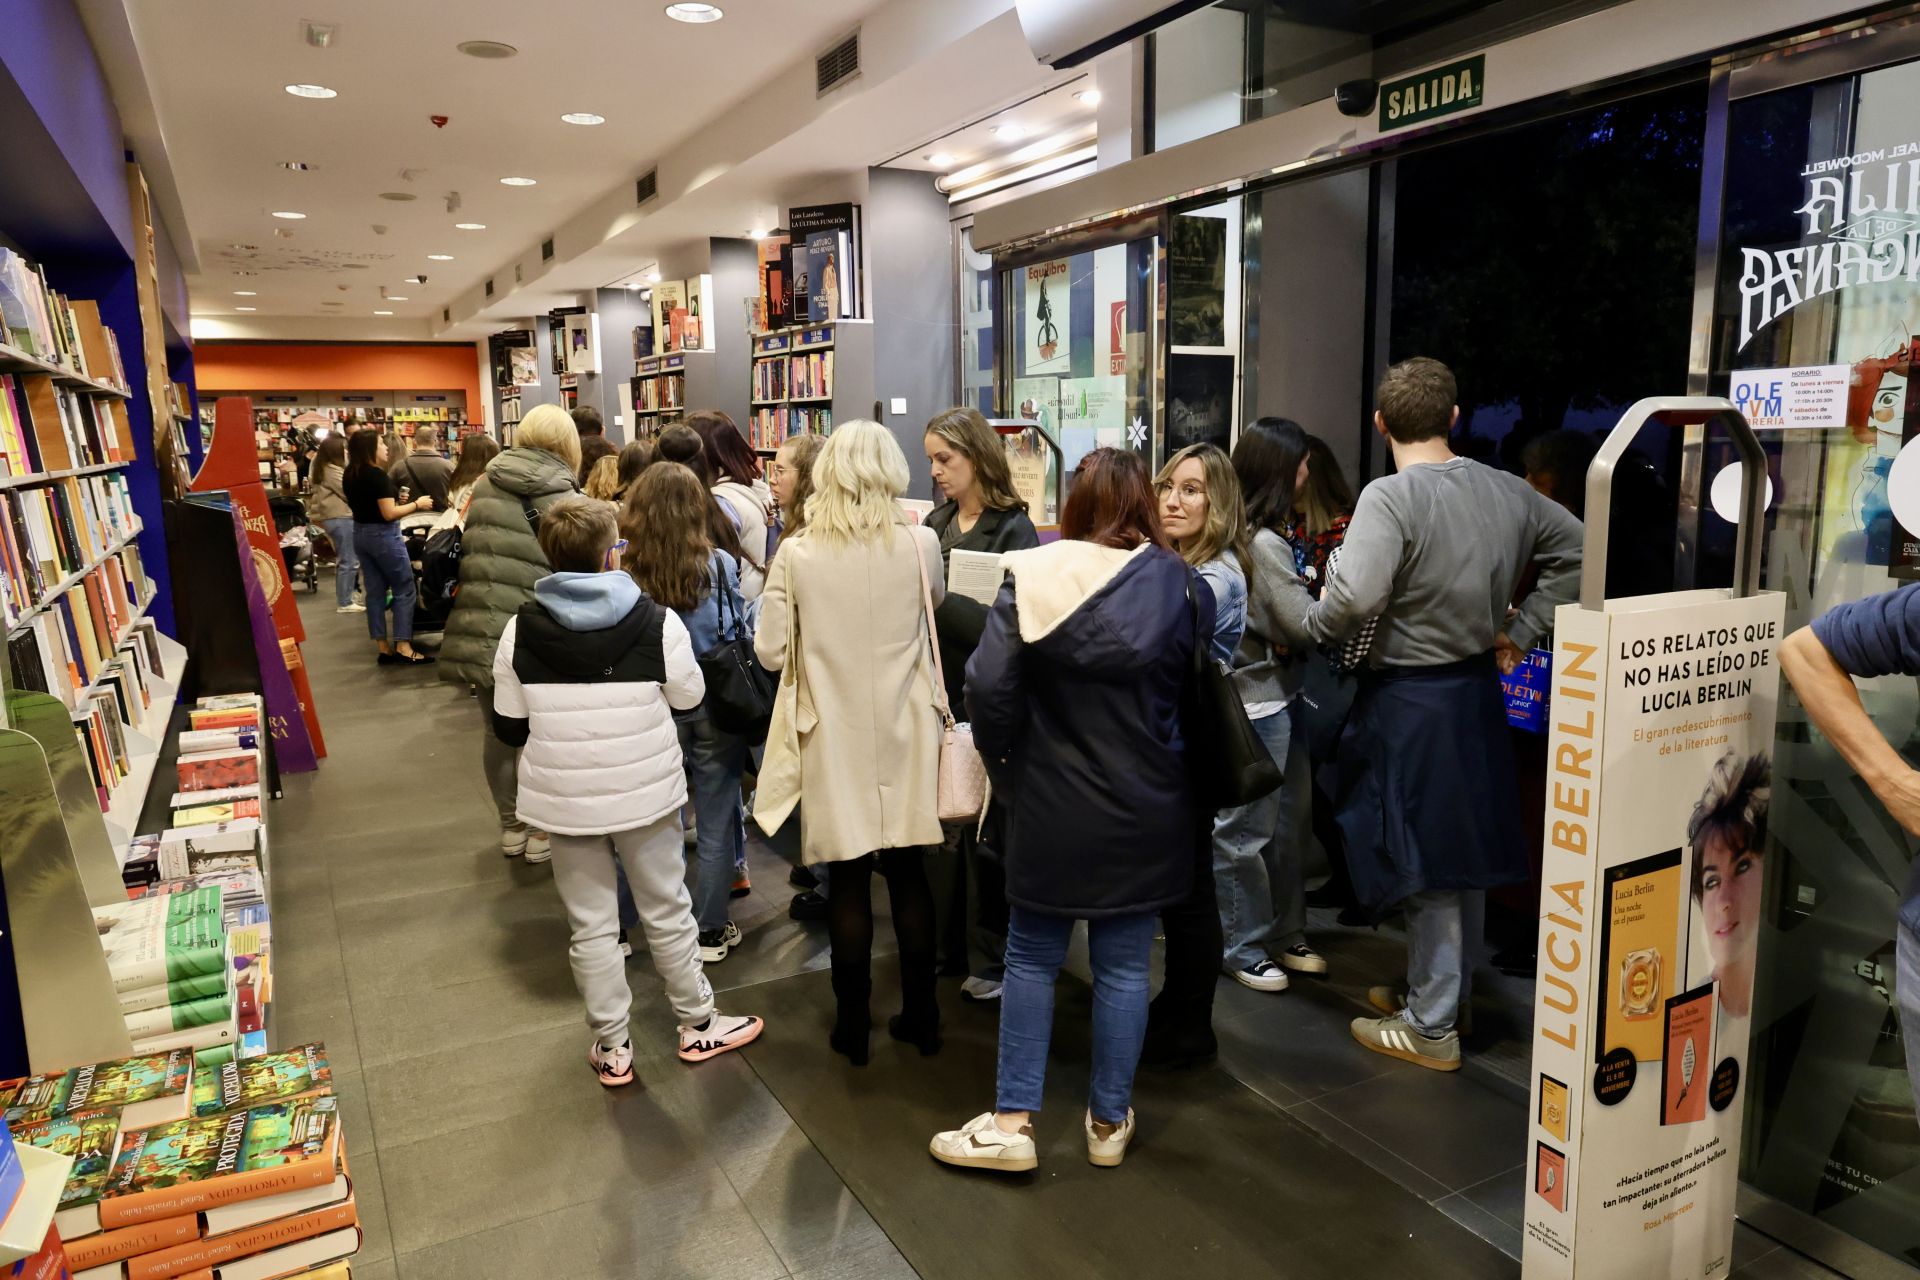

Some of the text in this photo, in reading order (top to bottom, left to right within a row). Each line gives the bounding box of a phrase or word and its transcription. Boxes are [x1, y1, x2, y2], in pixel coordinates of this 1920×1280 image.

[1388, 68, 1472, 120] SALIDA
[1735, 381, 1783, 401] OLE
[1735, 399, 1782, 417] TVM
[1621, 621, 1776, 660] LOS RELATOS QUE
[1624, 649, 1769, 688] NO HAS LEÍDO DE
[1641, 678, 1752, 714] LUCIA BERLIN
[1634, 711, 1752, 743] El gran redescubrimiento
[1659, 734, 1728, 756] de la literatura
[1541, 641, 1598, 1051] LUCIA BERLIN
[1615, 882, 1655, 900] Lucia Berlin
[66, 1064, 96, 1111] PROTEGIDA
[222, 1061, 241, 1107] PROTEGIDA
[216, 1111, 247, 1172] PROTEGIDA
[1644, 1163, 1670, 1178] tiempo
[1670, 1157, 1683, 1169] que
[1684, 1152, 1693, 1160] no
[1705, 1136, 1720, 1151] nada
[1603, 1200, 1617, 1209] tan
[1664, 1178, 1672, 1186] su
[1673, 1160, 1706, 1182] aterradora
[1707, 1148, 1727, 1164] belleza
[1642, 1199, 1658, 1210] deja
[1659, 1193, 1669, 1204] sin
[72, 1239, 140, 1263] PROTEGID
